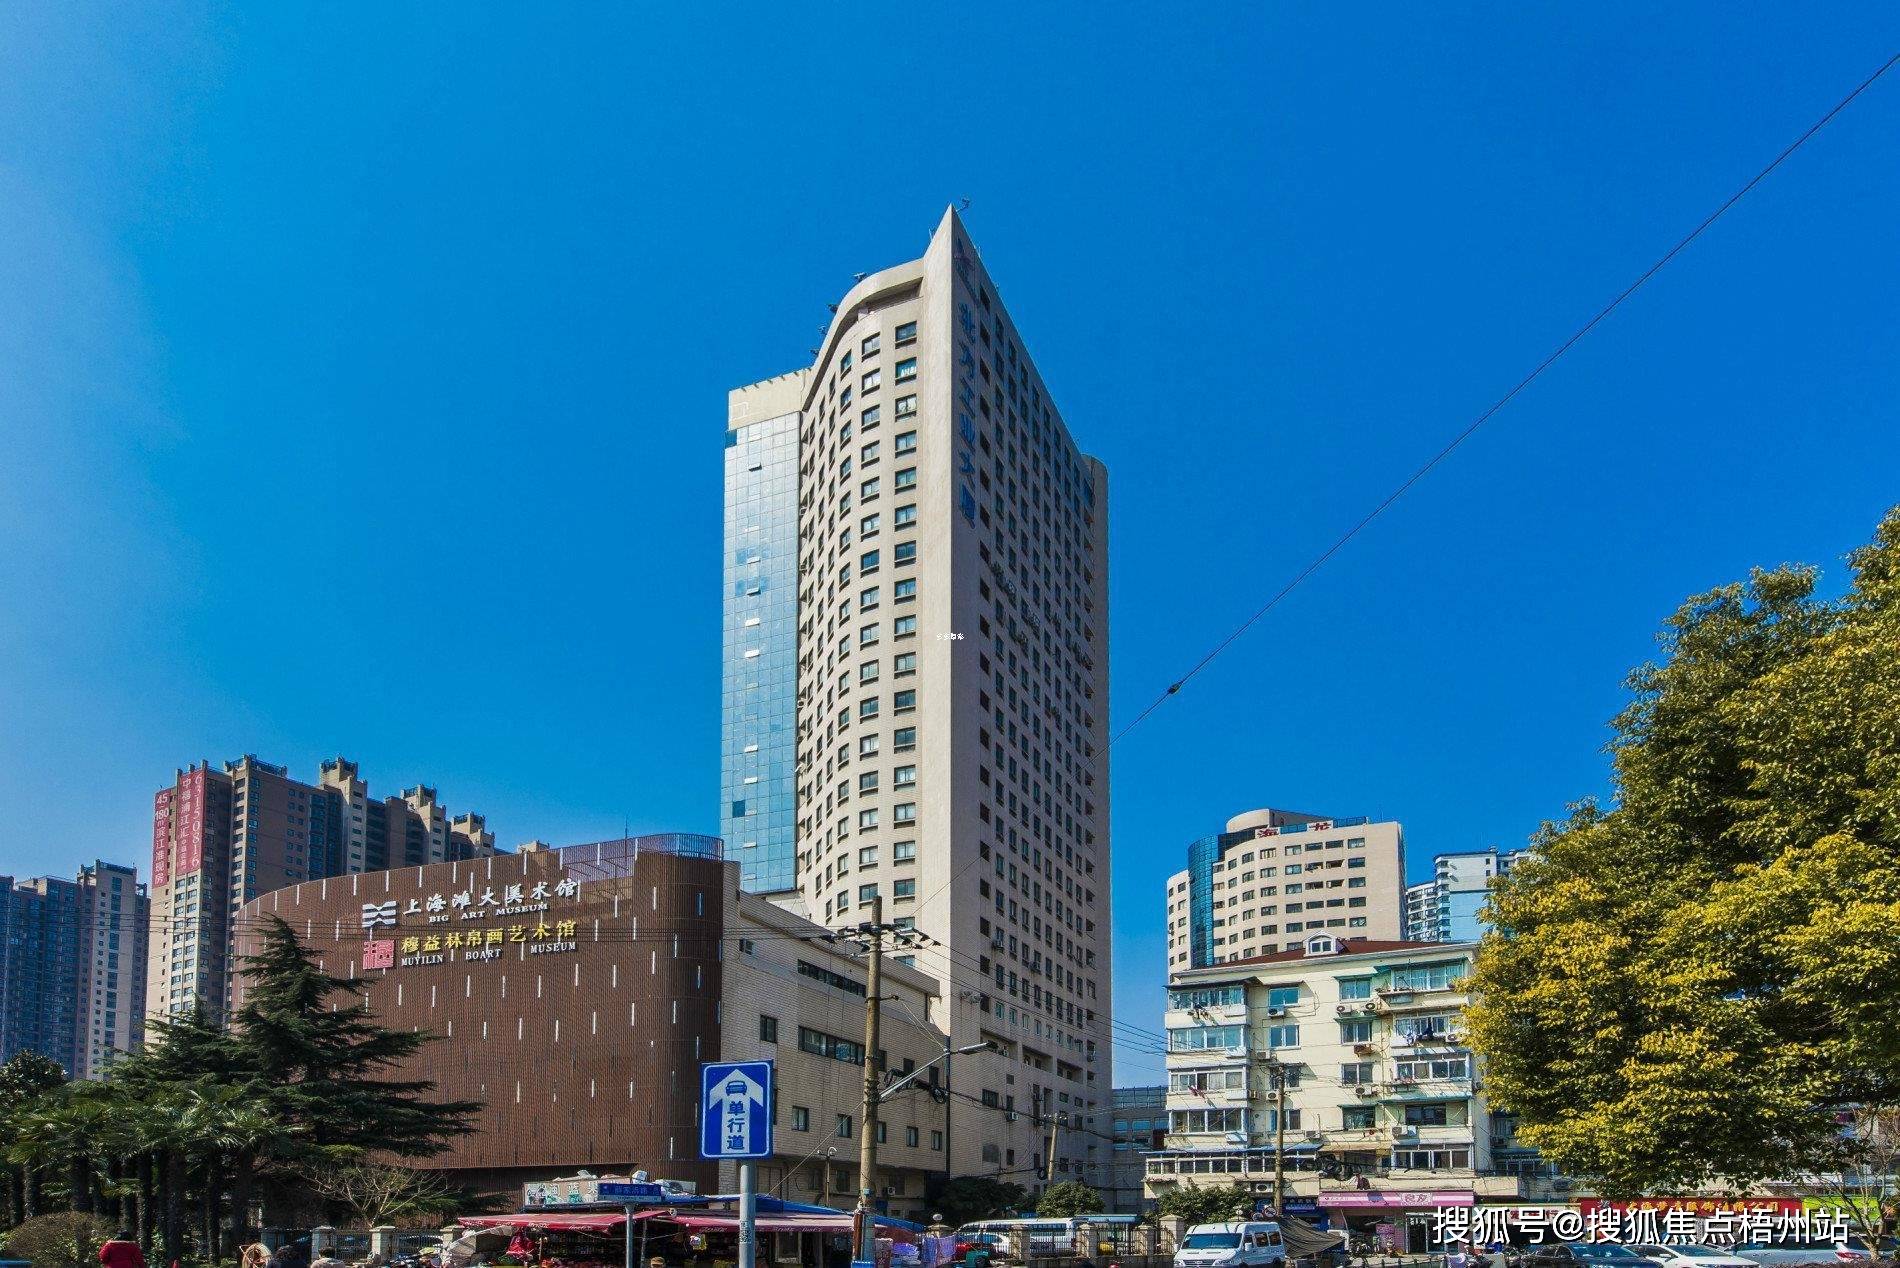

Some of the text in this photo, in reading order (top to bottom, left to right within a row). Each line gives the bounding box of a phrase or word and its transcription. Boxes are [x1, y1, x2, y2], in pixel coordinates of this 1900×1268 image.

[402, 878, 577, 915] 上海滩大美术馆
[429, 903, 548, 923] BIG ART MUSEUM
[401, 919, 577, 953] 穆益林帛画艺术馆
[401, 954, 444, 966] MUYILIN
[466, 948, 503, 960] BOART
[530, 941, 576, 954] MUSEUM
[727, 1101, 746, 1150] 单行道
